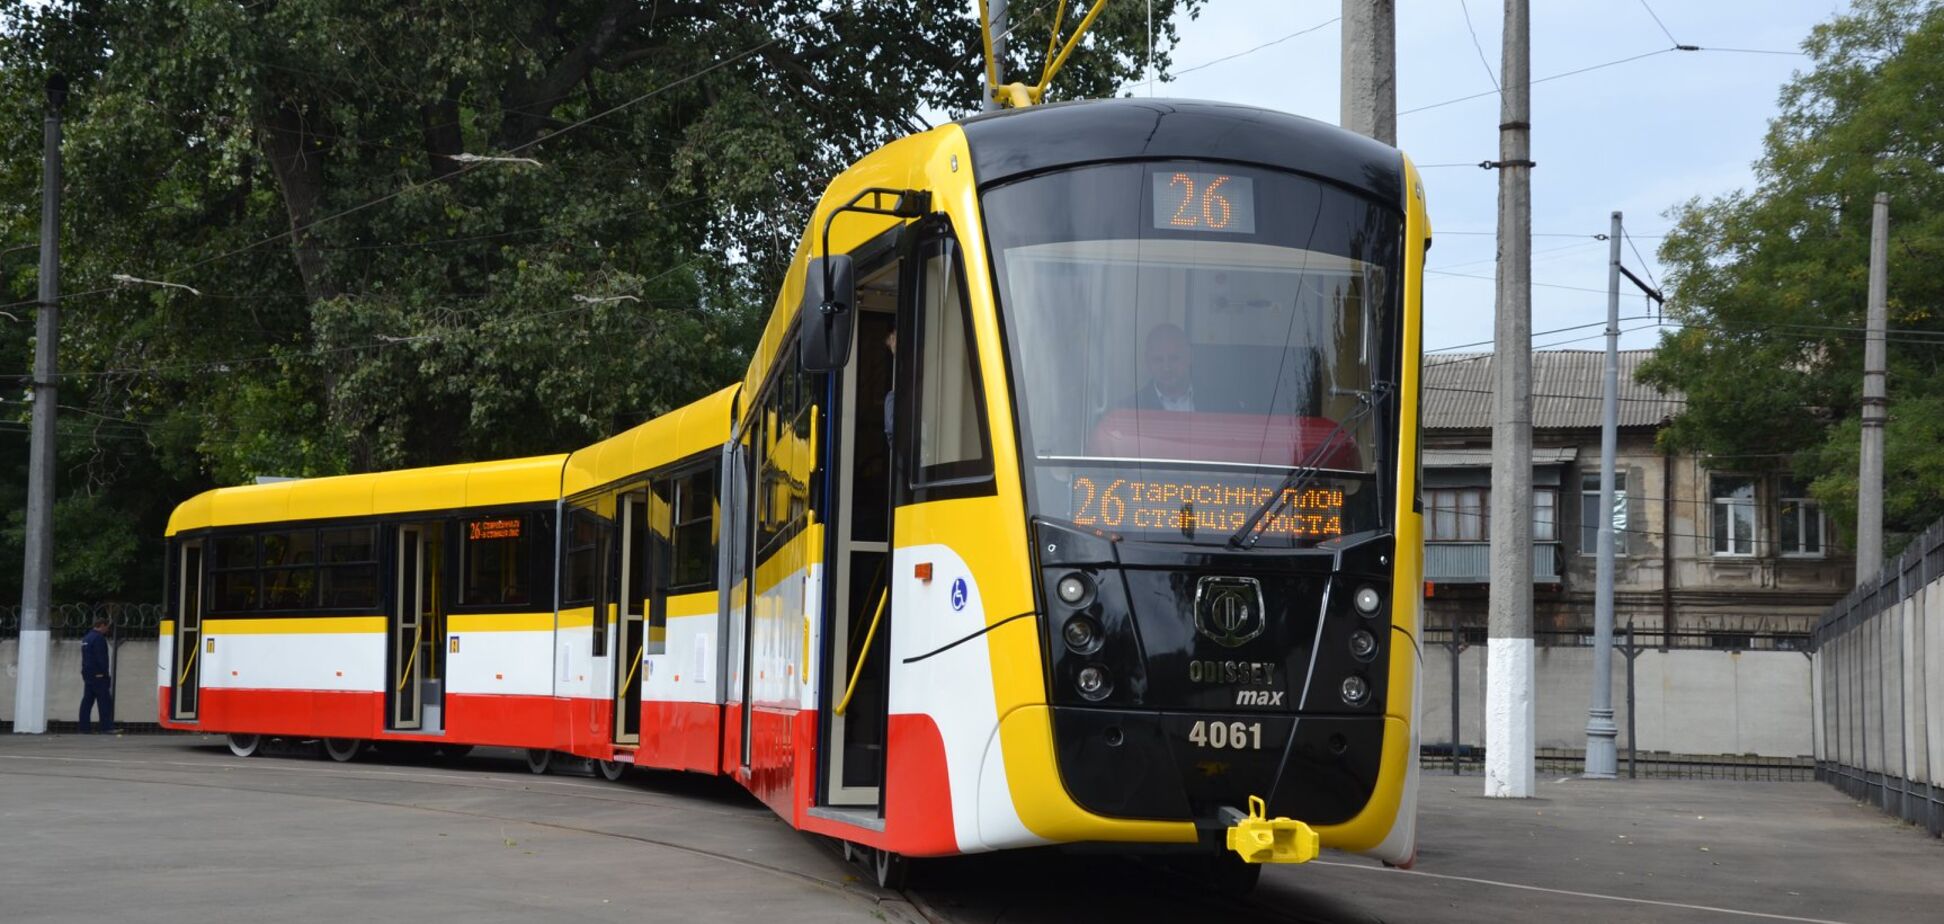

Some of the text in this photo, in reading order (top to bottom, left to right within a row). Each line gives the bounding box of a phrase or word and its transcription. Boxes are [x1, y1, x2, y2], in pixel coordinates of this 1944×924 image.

[1169, 172, 1231, 229] 26
[1073, 477, 1125, 527] 26
[1189, 659, 1276, 685] ODISSEY
[1236, 689, 1285, 706] max
[1188, 720, 1262, 750] 4061
